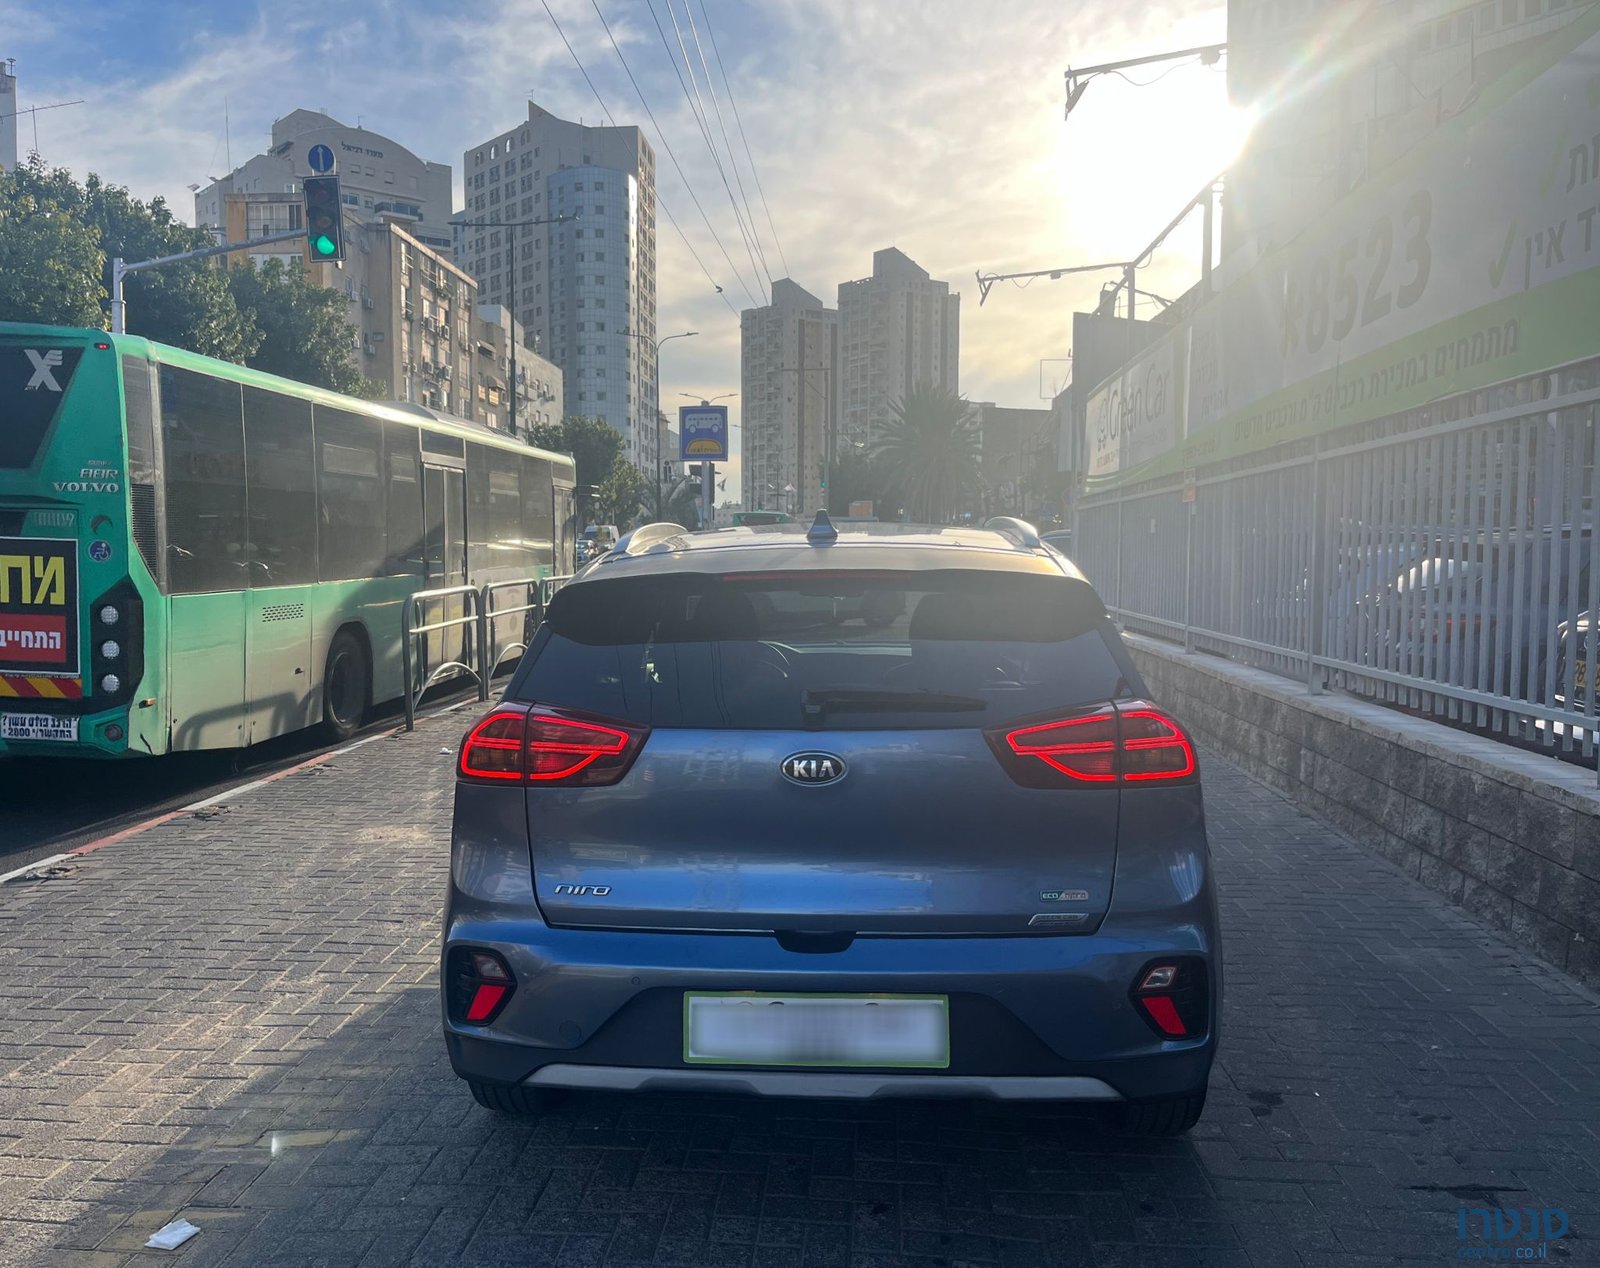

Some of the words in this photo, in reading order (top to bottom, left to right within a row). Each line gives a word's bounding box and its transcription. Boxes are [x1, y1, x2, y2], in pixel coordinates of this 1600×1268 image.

[1524, 219, 1567, 291] אין
[1434, 319, 1520, 377] מתמחים
[1145, 363, 1169, 423] Car
[1367, 352, 1428, 400] במכירת
[51, 481, 120, 493] VOLVO
[792, 758, 836, 778] KIA
[554, 884, 611, 896] niro
